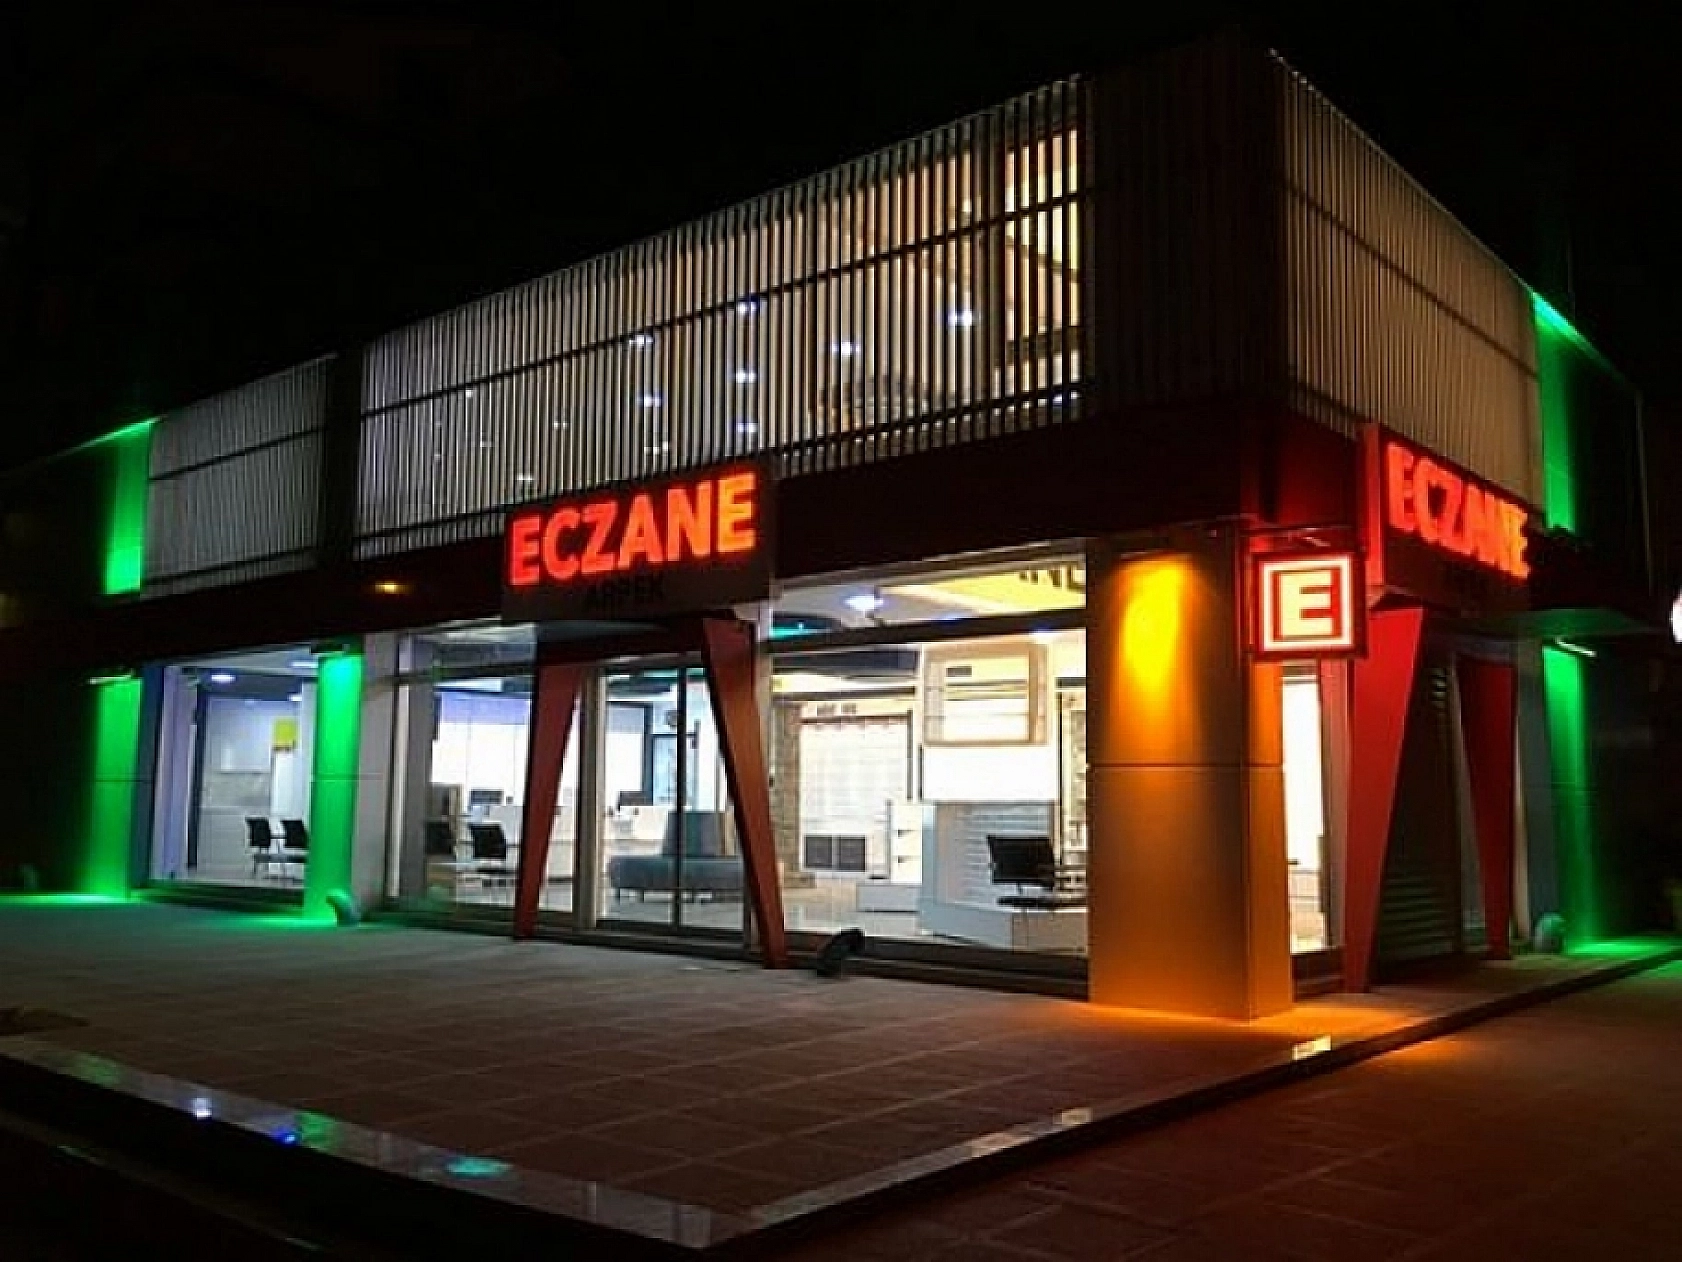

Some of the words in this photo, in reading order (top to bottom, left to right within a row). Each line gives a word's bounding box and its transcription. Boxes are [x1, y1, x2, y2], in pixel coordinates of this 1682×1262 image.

[509, 472, 757, 587] ECZANE
[1386, 441, 1531, 580] ECZANE
[1278, 568, 1334, 637] E
